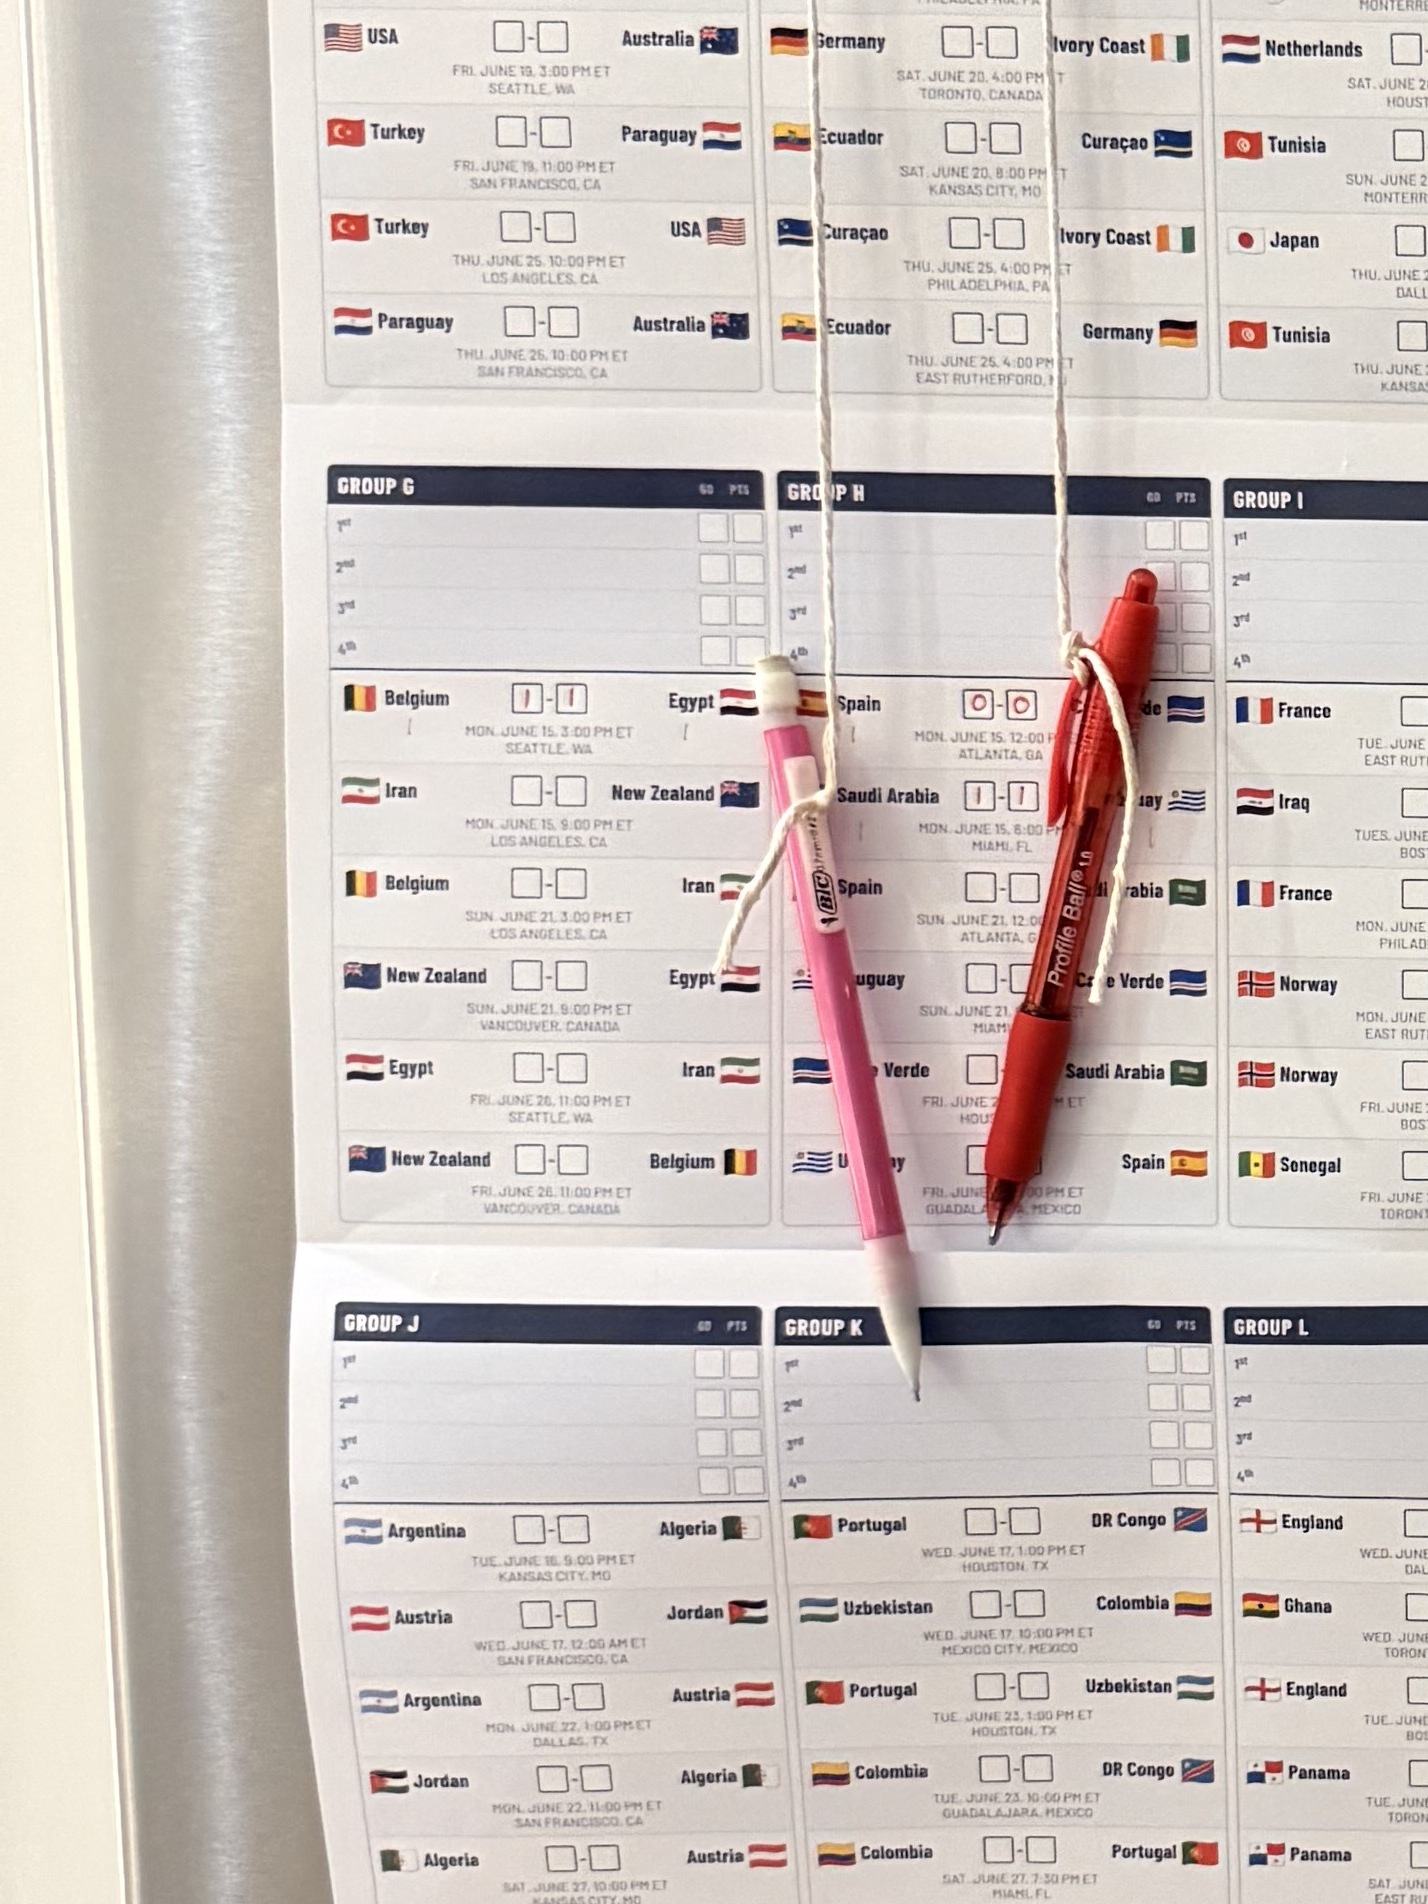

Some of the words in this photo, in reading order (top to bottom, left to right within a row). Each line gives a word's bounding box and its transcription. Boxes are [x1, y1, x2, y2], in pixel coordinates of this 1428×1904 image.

[1234, 491, 1291, 508] GROUP
[1298, 492, 1302, 509] I
[385, 690, 449, 710] Belgium
[1279, 702, 1331, 718] France
[612, 785, 645, 800] New
[651, 785, 714, 801] Zealand
[837, 787, 881, 803] Saudi
[887, 788, 939, 803] Arabia
[815, 875, 835, 911] BIC
[1047, 925, 1077, 988] Profile
[1234, 1319, 1292, 1335] GROUP
[1299, 1319, 1308, 1335] L
[388, 1523, 466, 1542] Argentina
[1282, 1514, 1343, 1533] England
[844, 1600, 933, 1615] Uzbekistan
